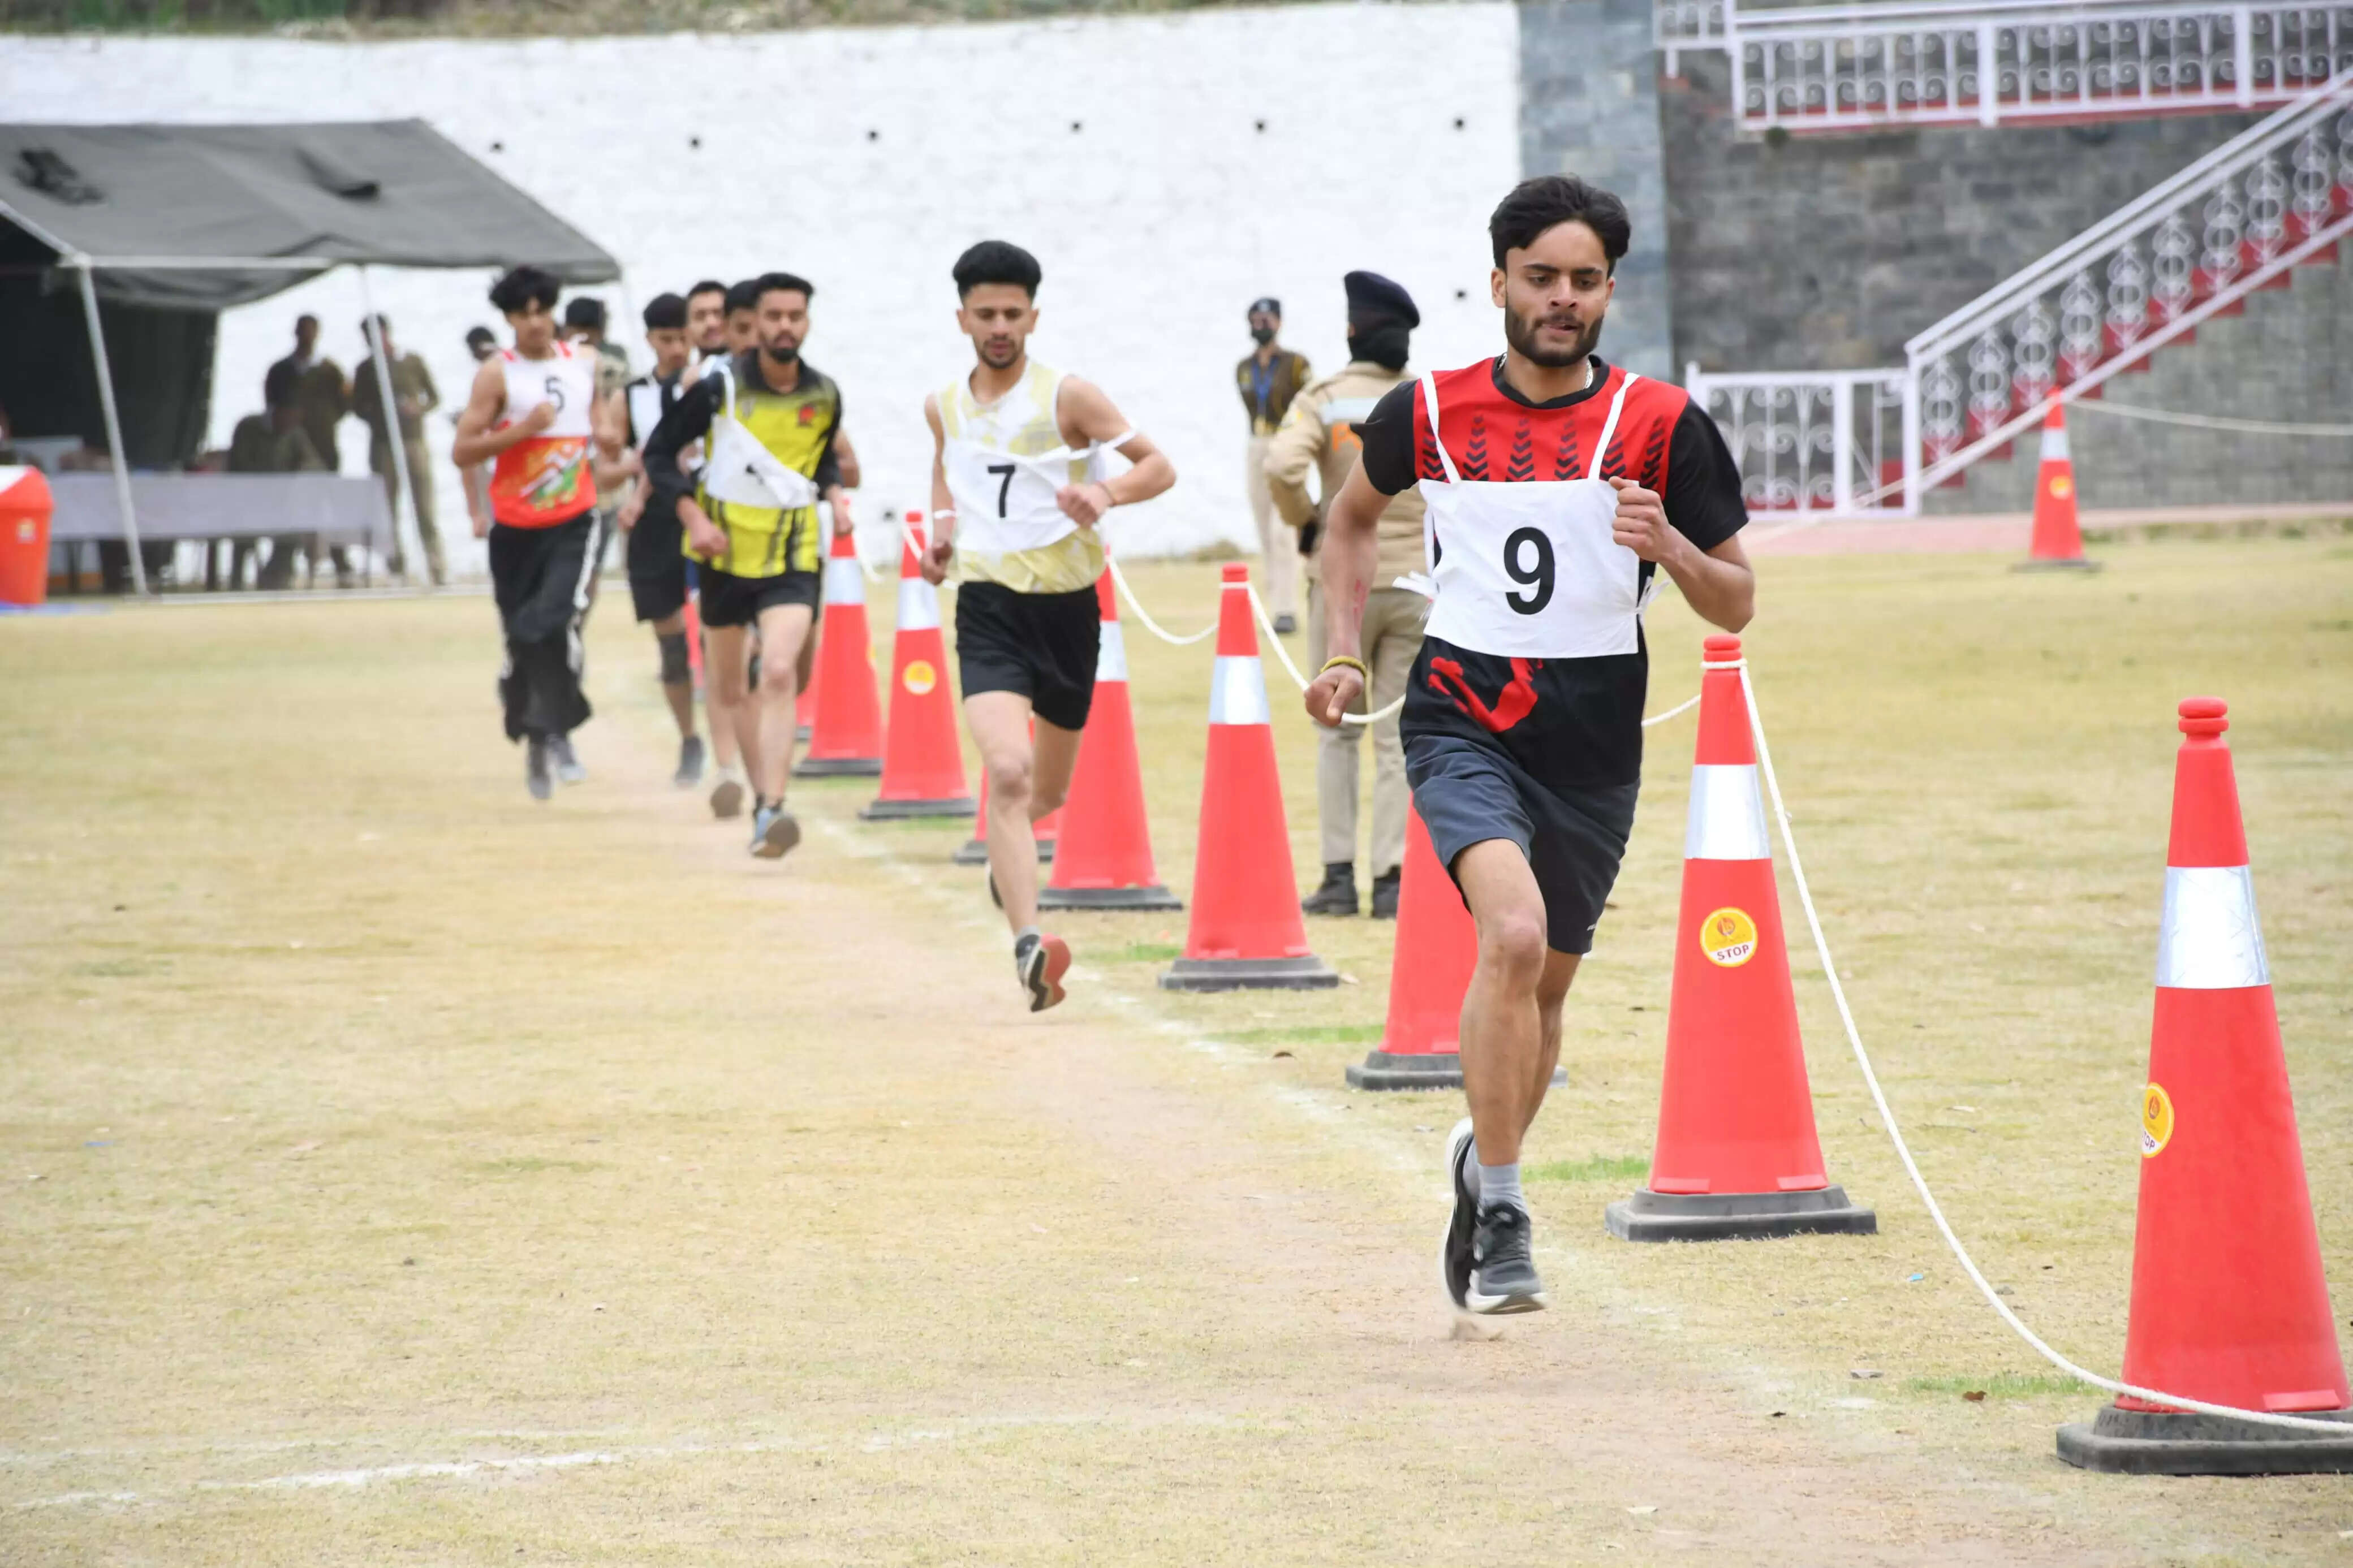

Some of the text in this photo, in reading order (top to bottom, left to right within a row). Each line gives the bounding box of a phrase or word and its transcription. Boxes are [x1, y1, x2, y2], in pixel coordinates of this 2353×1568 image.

[545, 376, 564, 413] 5
[987, 464, 1016, 518] 7
[1503, 526, 1555, 615] 9
[1716, 944, 1749, 961] STOP
